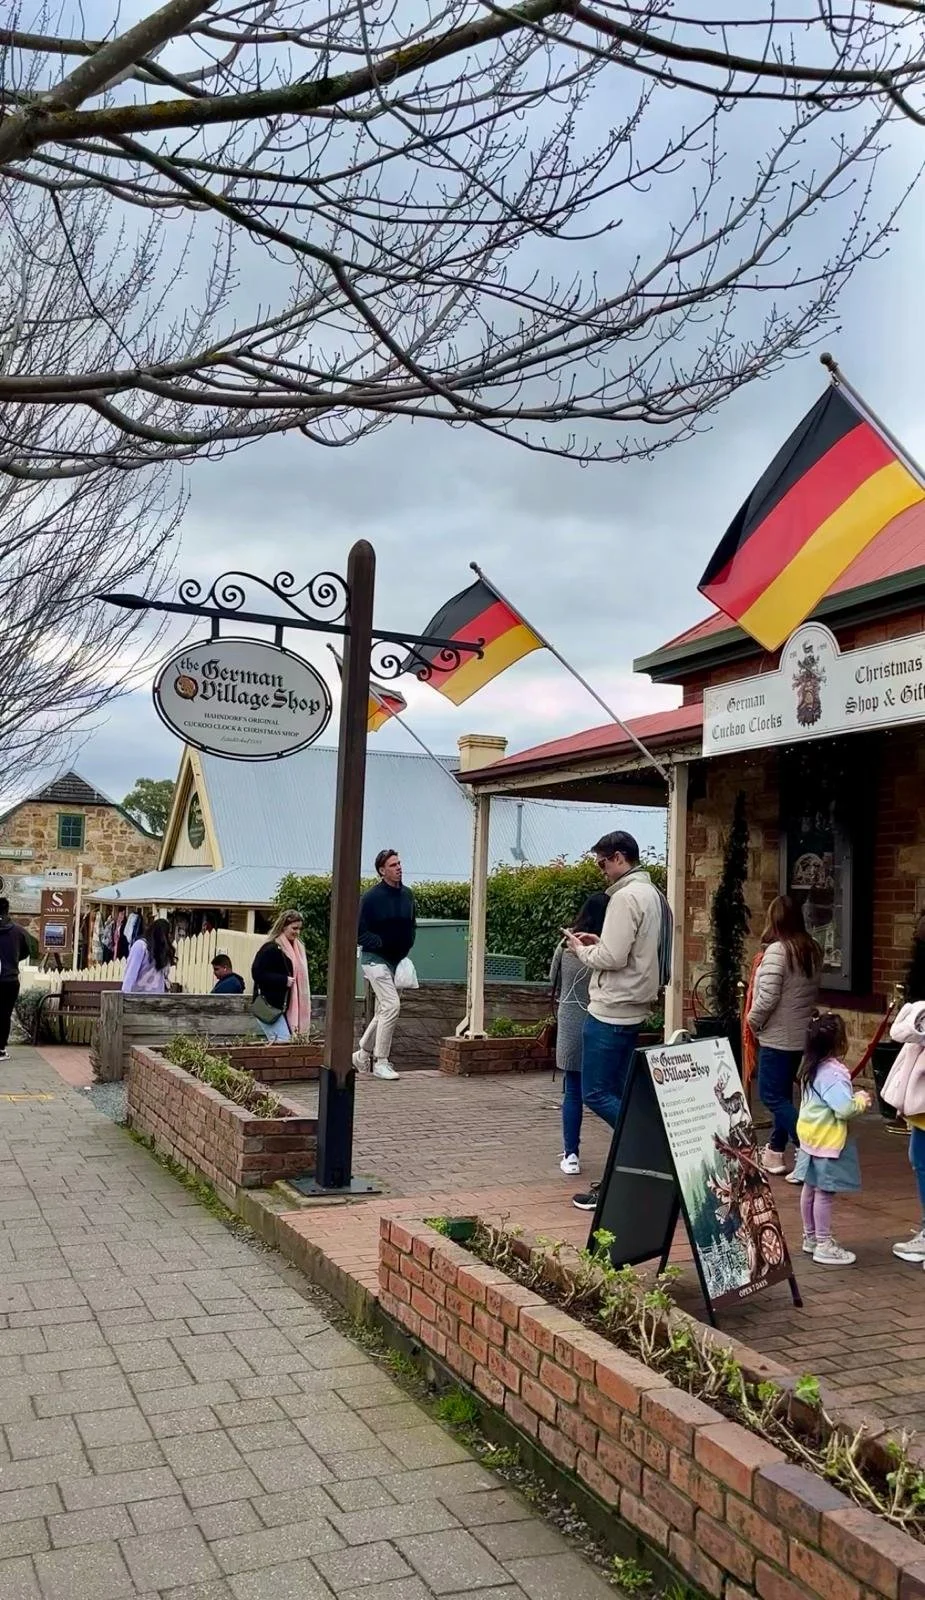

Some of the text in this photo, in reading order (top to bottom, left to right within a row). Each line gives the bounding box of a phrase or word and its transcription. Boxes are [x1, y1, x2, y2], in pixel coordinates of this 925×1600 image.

[180, 657, 285, 687] the German
[855, 656, 923, 684] Christmas
[199, 680, 320, 716] Village Shop
[727, 693, 765, 713] German
[845, 696, 879, 716] Shop
[883, 687, 896, 707] &
[183, 720, 213, 729] CUCKOO
[213, 723, 237, 732] CLOCK
[243, 726, 281, 736] CHRISTMAS
[281, 730, 300, 738] SHOP
[247, 716, 279, 725] ORIGINAL
[711, 714, 783, 742] Cuckoo Clocks
[51, 891, 64, 907] S
[650, 1052, 693, 1067] the German
[663, 1062, 710, 1083] Village Shop
[738, 1286, 753, 1298] OPEN
[755, 1279, 768, 1290] DAYS
